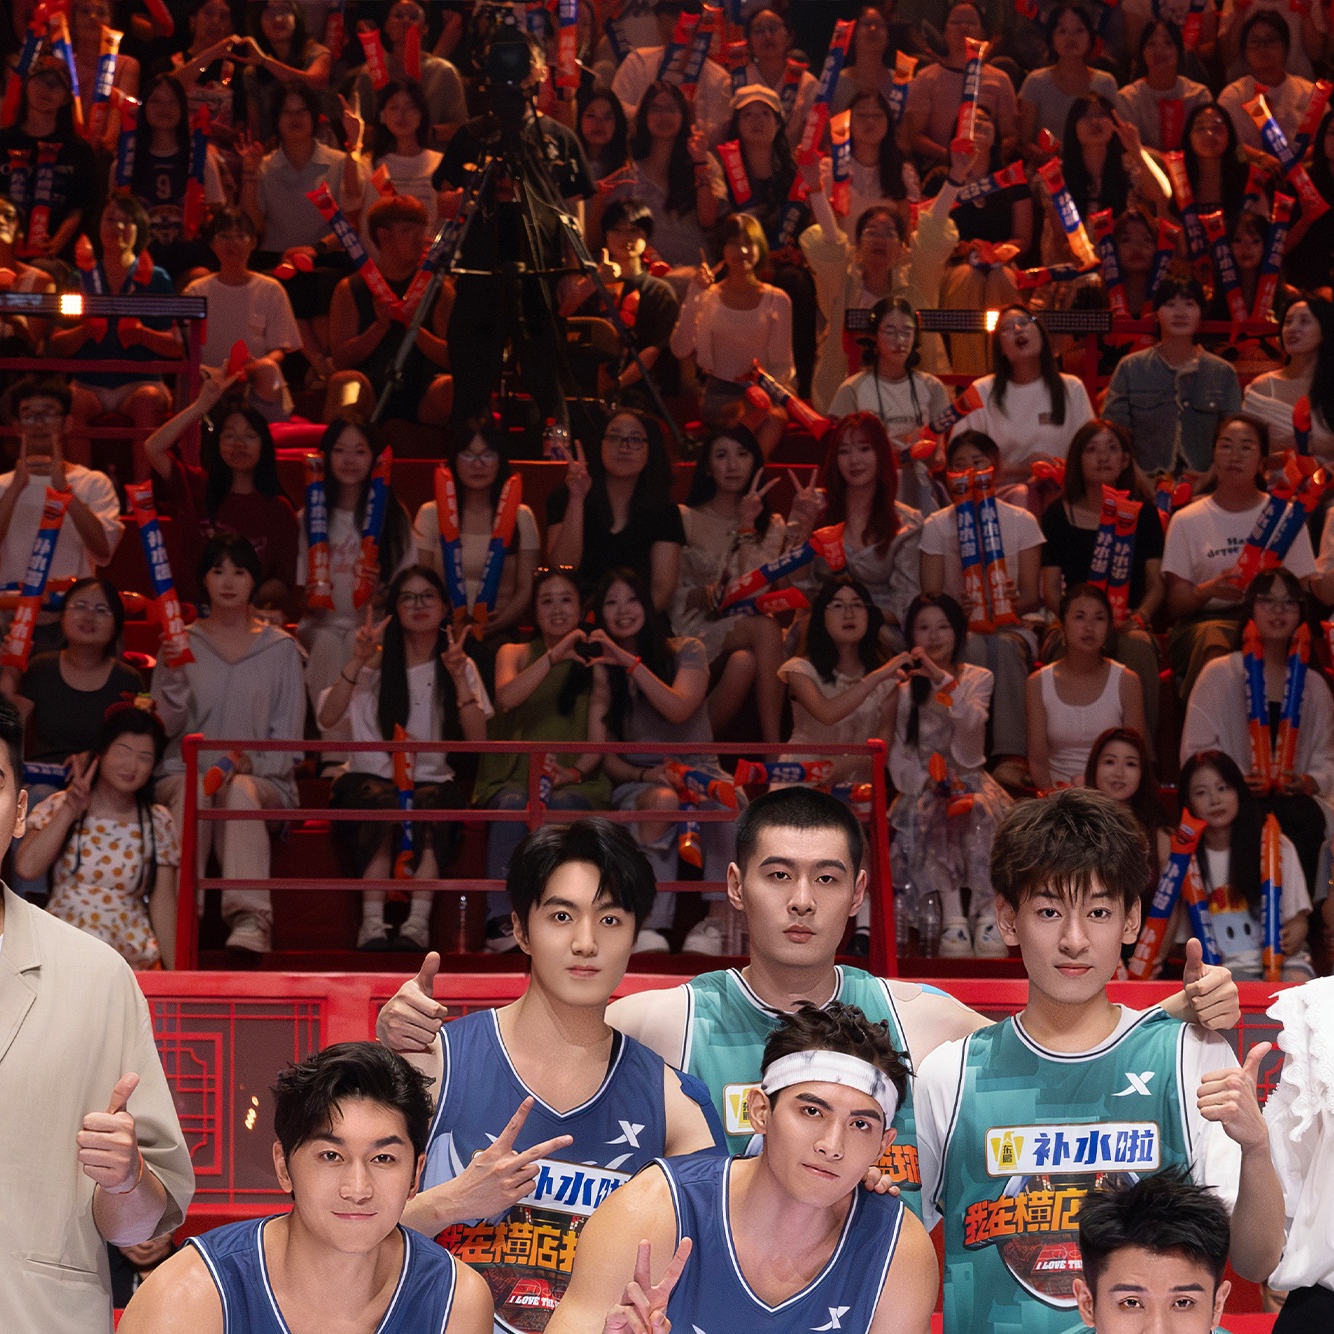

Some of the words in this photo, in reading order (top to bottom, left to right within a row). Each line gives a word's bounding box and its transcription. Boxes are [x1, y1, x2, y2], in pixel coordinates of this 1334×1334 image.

[1032, 1129, 1155, 1167] 补水啦
[1043, 1260, 1066, 1270] LOVE
[517, 1296, 540, 1306] LOVE
